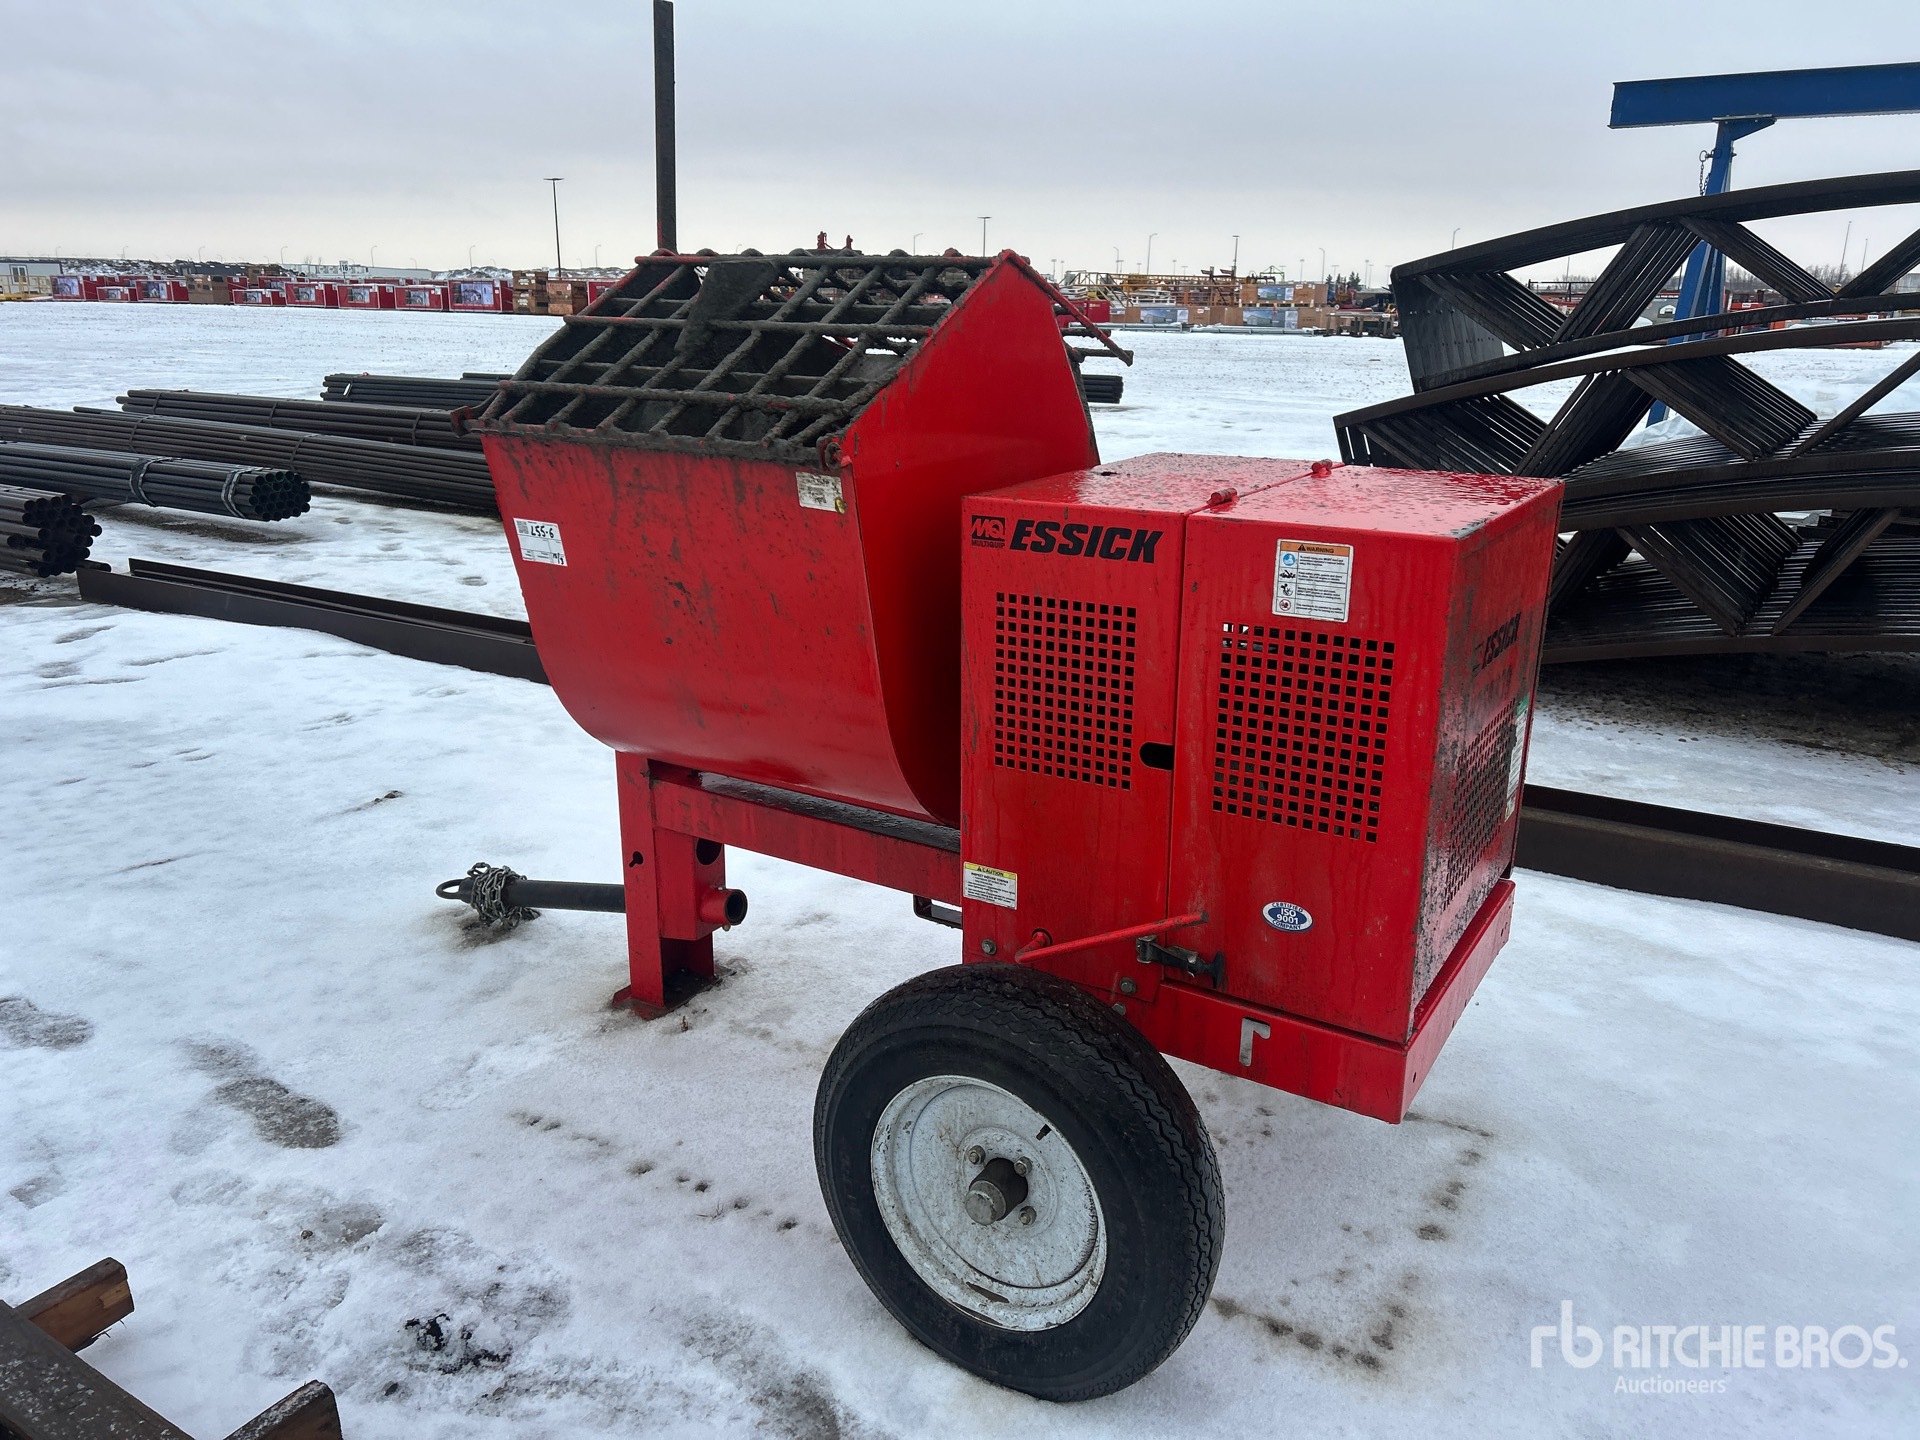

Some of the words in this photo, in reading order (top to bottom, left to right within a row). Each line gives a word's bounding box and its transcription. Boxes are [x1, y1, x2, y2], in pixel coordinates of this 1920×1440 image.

[1009, 519, 1164, 564] ESSICK
[982, 868, 1004, 877] CAUTION
[1281, 908, 1297, 917] ISO
[1276, 913, 1299, 925] 9001
